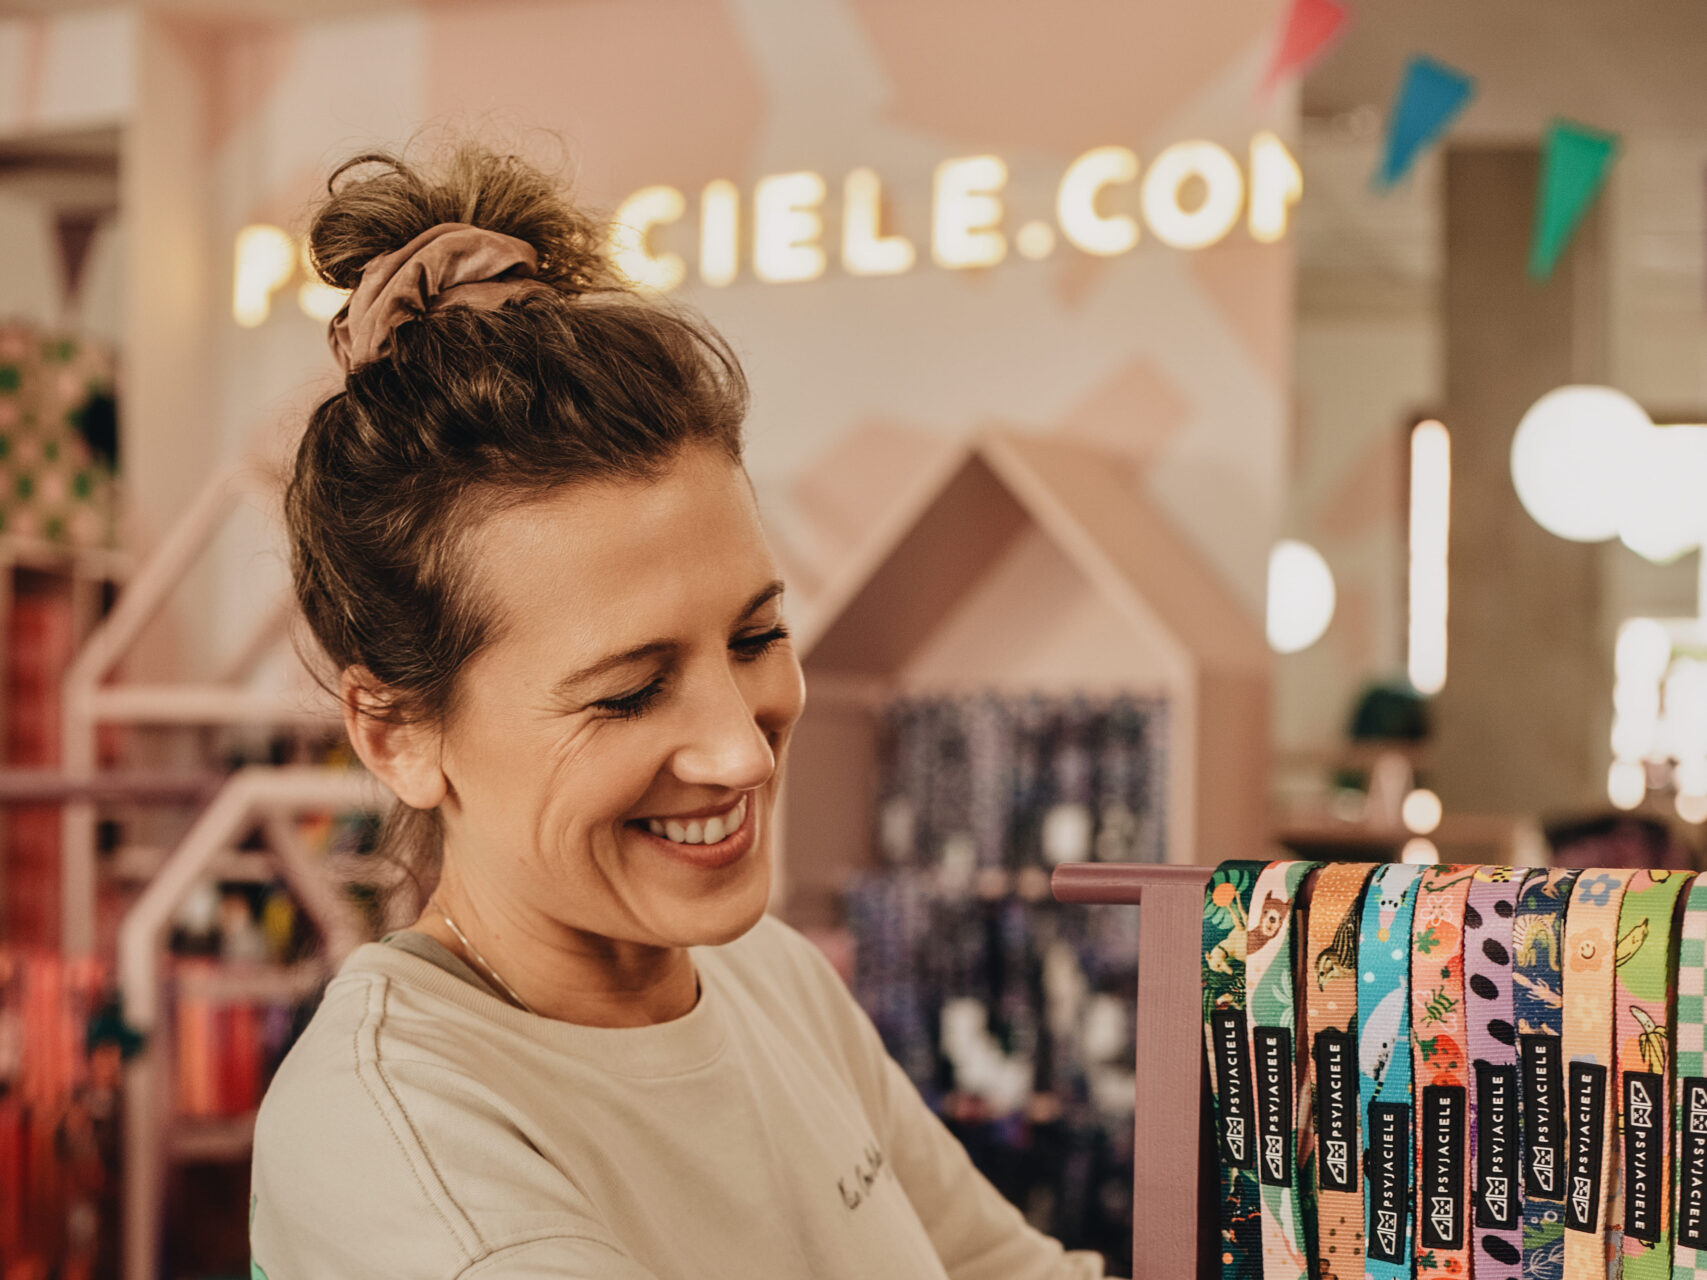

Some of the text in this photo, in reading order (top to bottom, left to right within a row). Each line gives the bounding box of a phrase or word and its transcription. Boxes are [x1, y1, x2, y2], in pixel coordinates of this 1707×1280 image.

[1224, 1019, 1240, 1114] PSYJACIELE
[1266, 1037, 1280, 1132] PSYJACIELE
[1329, 1044, 1344, 1138] PSYJACIELE
[1535, 1045, 1550, 1143] PSYJACIELE
[1383, 1113, 1395, 1208] PSYJACIELE
[1437, 1097, 1451, 1193] PSYJACIELE
[1491, 1075, 1504, 1173] PSYJACIELE
[1578, 1074, 1593, 1173] PSYJACIELE
[1634, 1132, 1648, 1231] PSYJACIELE
[1688, 1137, 1706, 1239] PSYJACIELE
